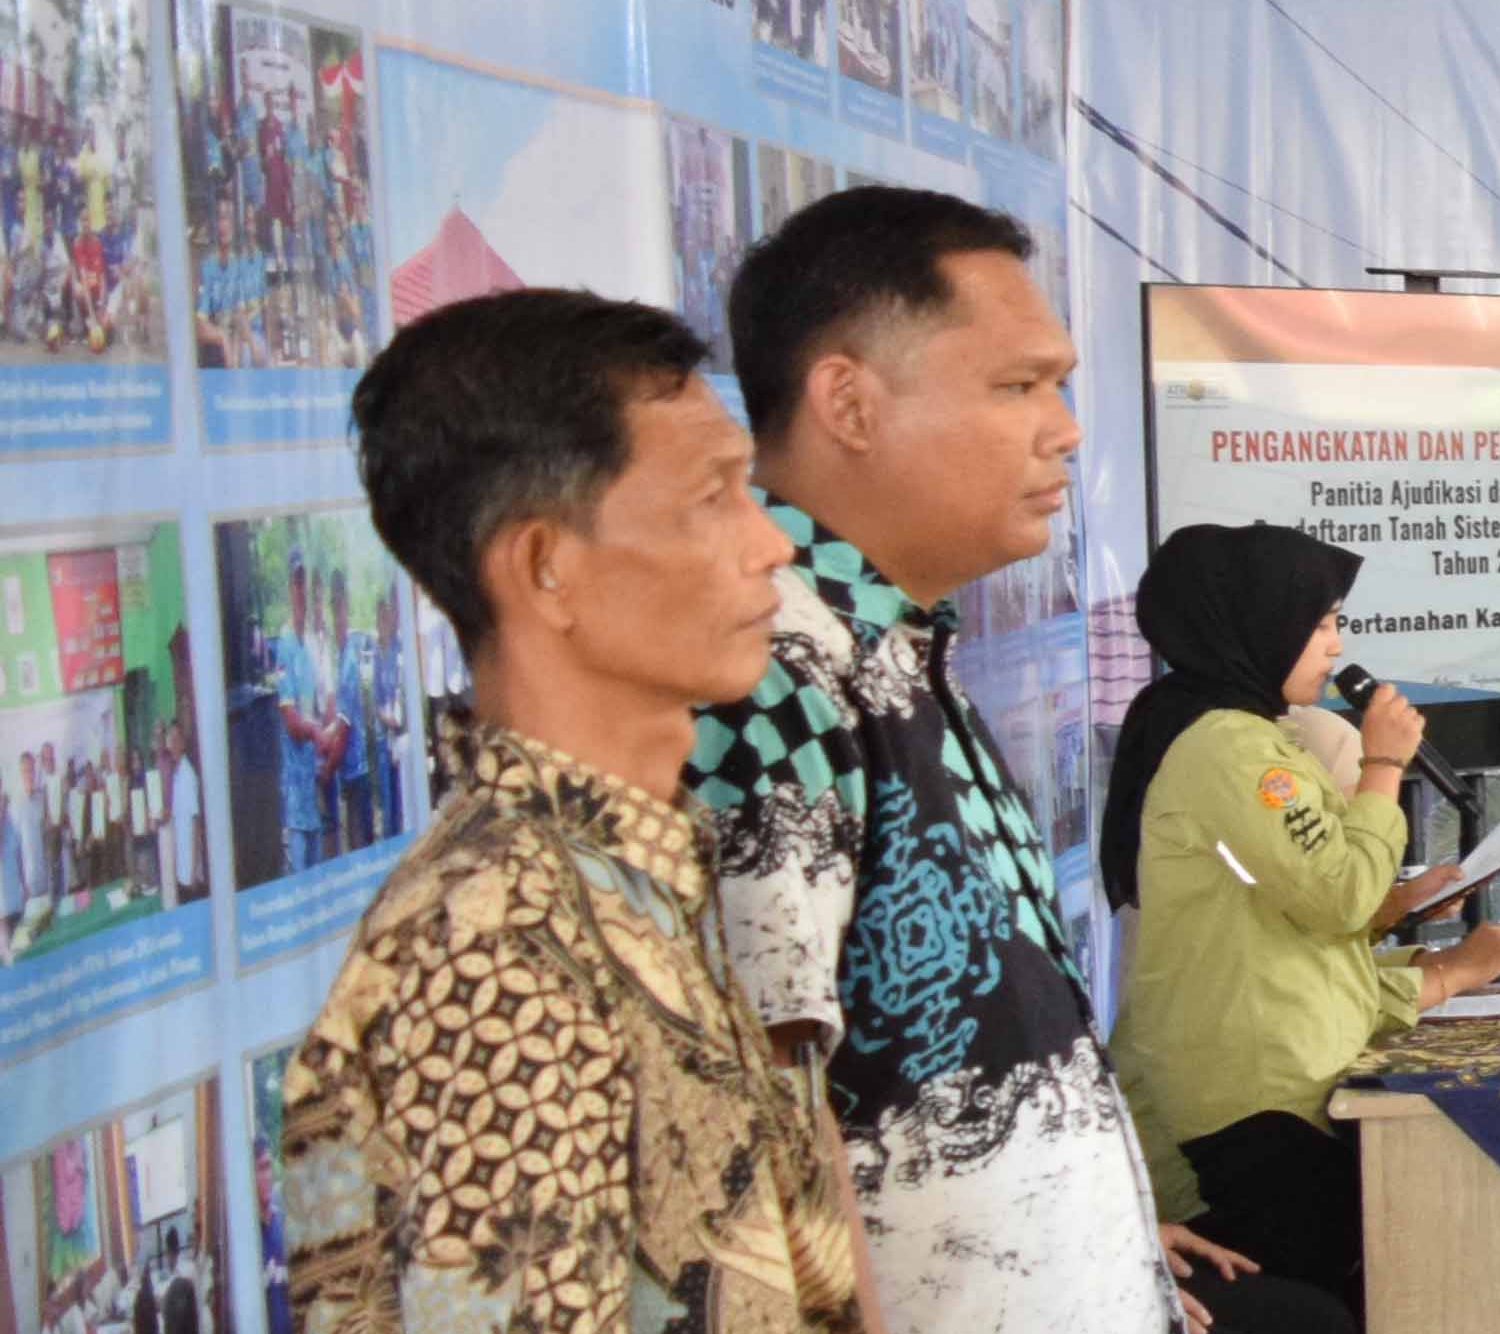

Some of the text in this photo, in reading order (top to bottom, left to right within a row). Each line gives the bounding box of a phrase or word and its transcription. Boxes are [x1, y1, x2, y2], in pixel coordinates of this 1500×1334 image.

[1212, 431, 1408, 463] PENGANGKATAN
[1419, 431, 1464, 461] DAN
[1311, 481, 1383, 507] Panitia
[1391, 481, 1481, 511] Ajudikasi
[1389, 515, 1446, 541] Tanah
[1432, 550, 1489, 577] Tahun
[1336, 609, 1468, 635] Pertanahan
